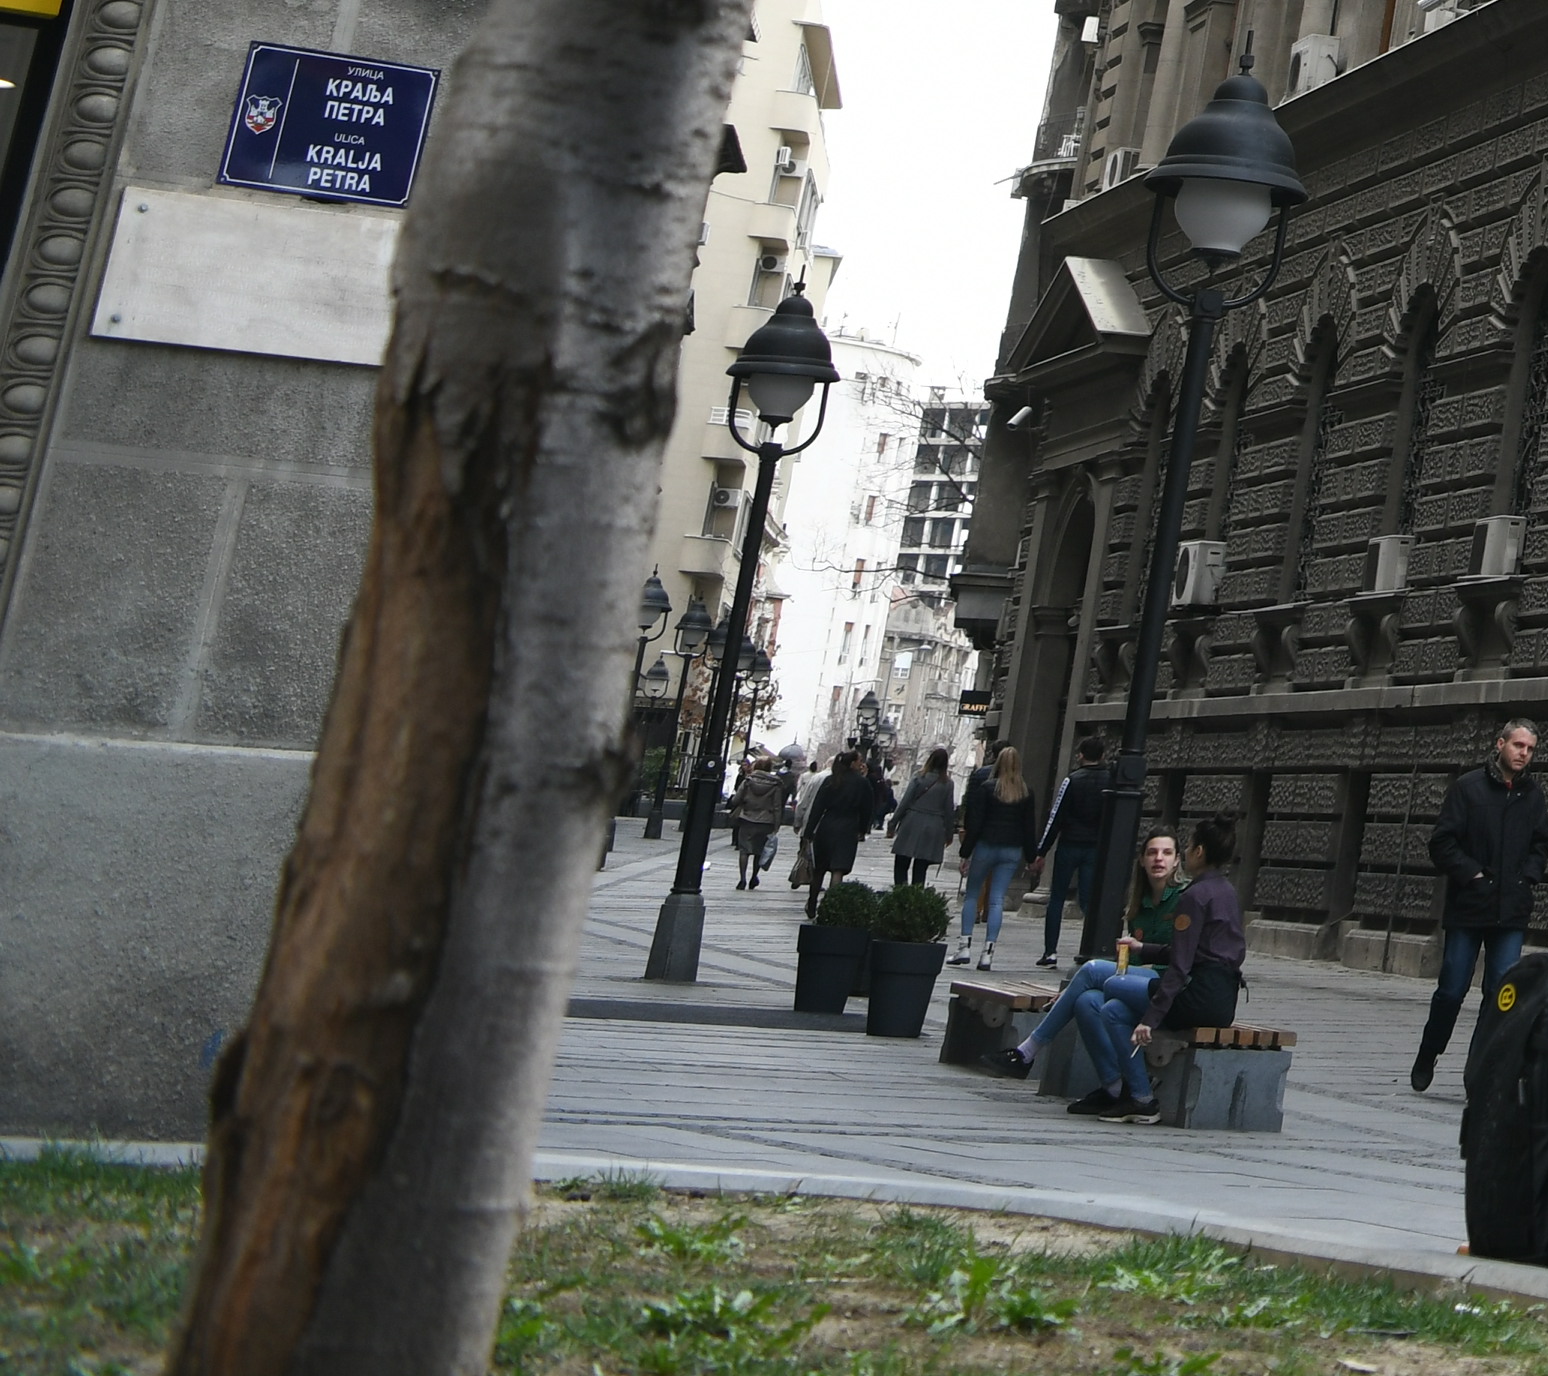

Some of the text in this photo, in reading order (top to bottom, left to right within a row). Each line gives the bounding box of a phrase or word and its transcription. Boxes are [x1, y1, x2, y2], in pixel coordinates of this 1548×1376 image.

[347, 66, 384, 81] УЛИЦА
[325, 78, 394, 105] КРАЉА
[324, 100, 385, 126] ПЕТРА
[334, 132, 365, 145] ULICA
[306, 144, 382, 171] KRALJA
[307, 167, 371, 192] PETRA
